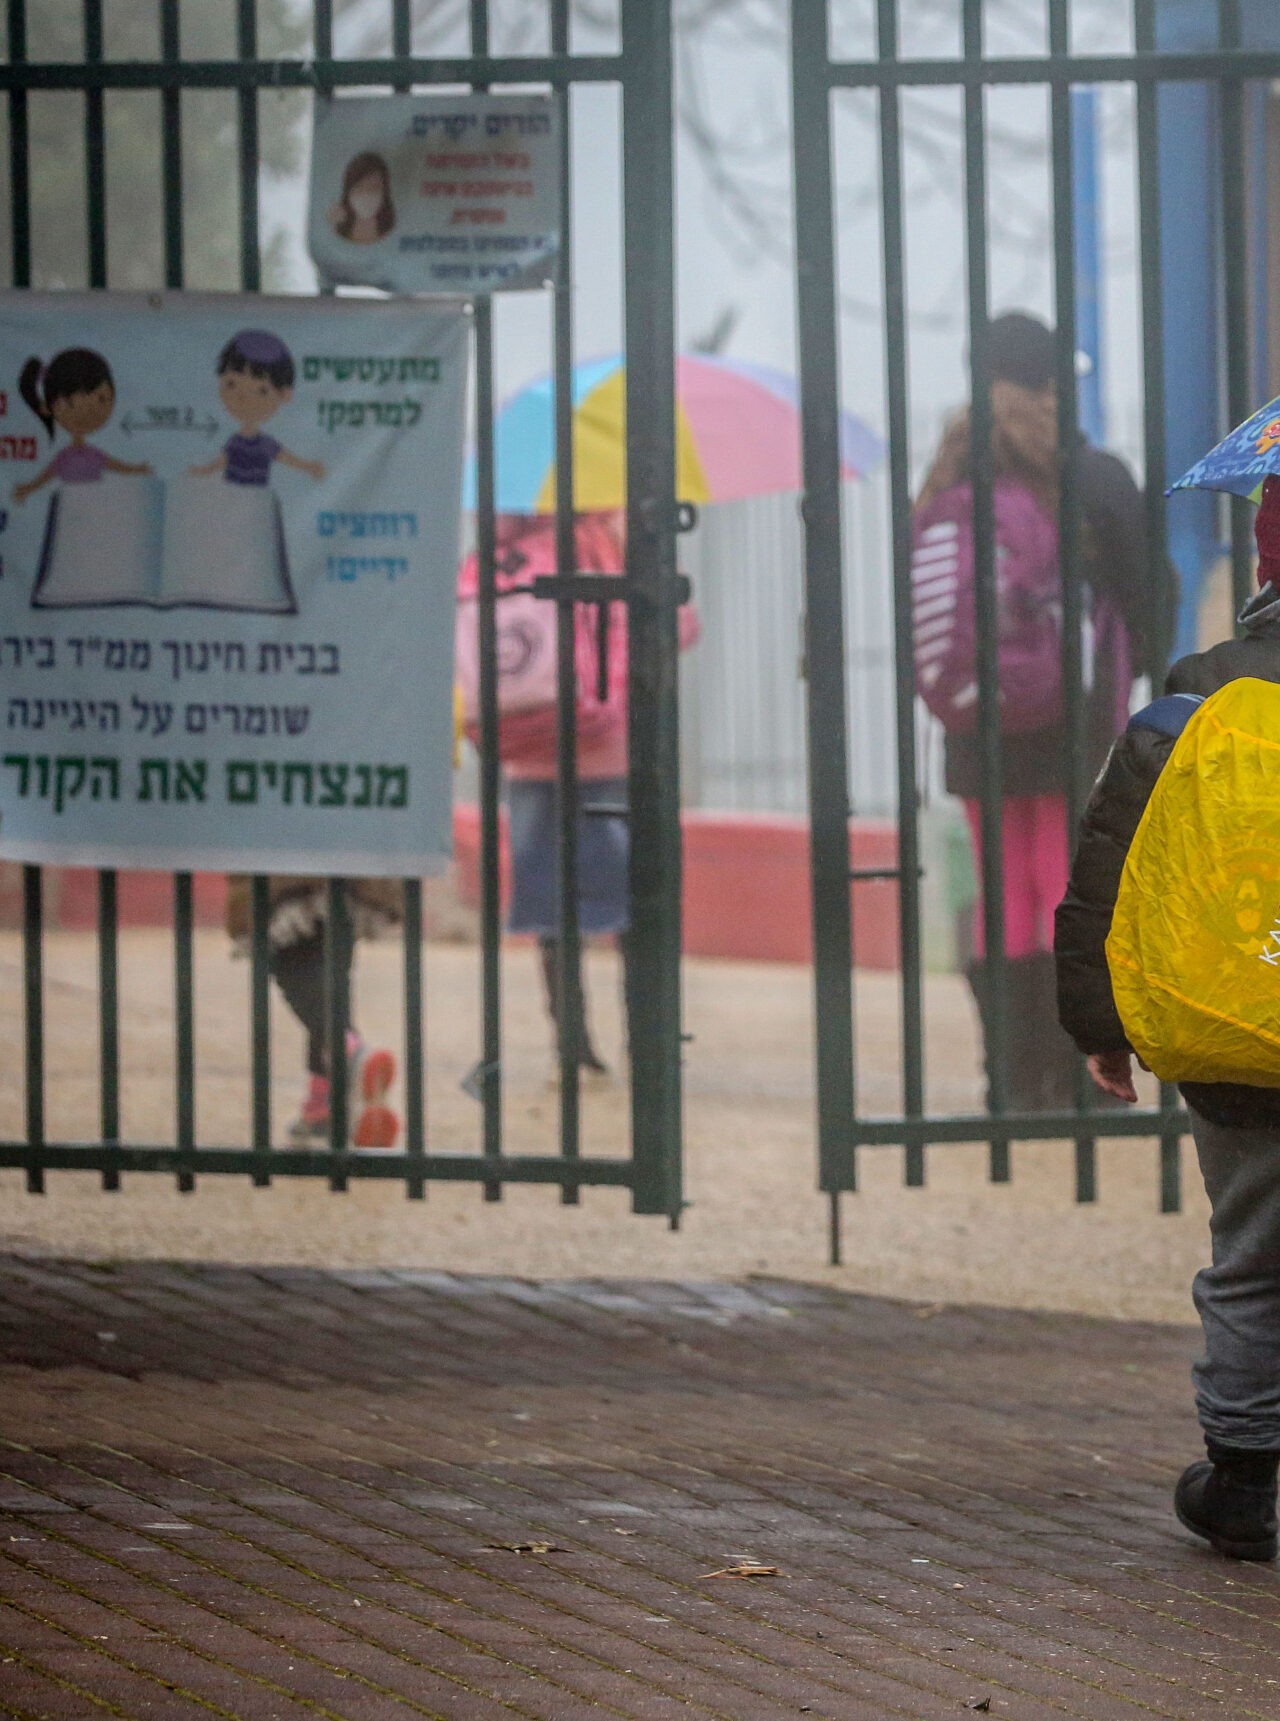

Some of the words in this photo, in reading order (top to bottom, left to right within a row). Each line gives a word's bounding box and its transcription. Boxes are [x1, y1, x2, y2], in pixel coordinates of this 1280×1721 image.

[303, 356, 440, 385] מתעטשים
[318, 398, 423, 434] למרפק!
[317, 512, 418, 538] רוחצים
[328, 556, 408, 582] ידיים!
[0, 637, 55, 669] ביר
[68, 637, 152, 671] ממ"ד
[162, 641, 245, 681] חינוך
[260, 644, 341, 676] בבית
[8, 698, 120, 732] היגיינה
[132, 694, 175, 737] על
[185, 703, 311, 737] שומרים
[137, 757, 208, 804] את
[225, 759, 411, 809] מנצחים
